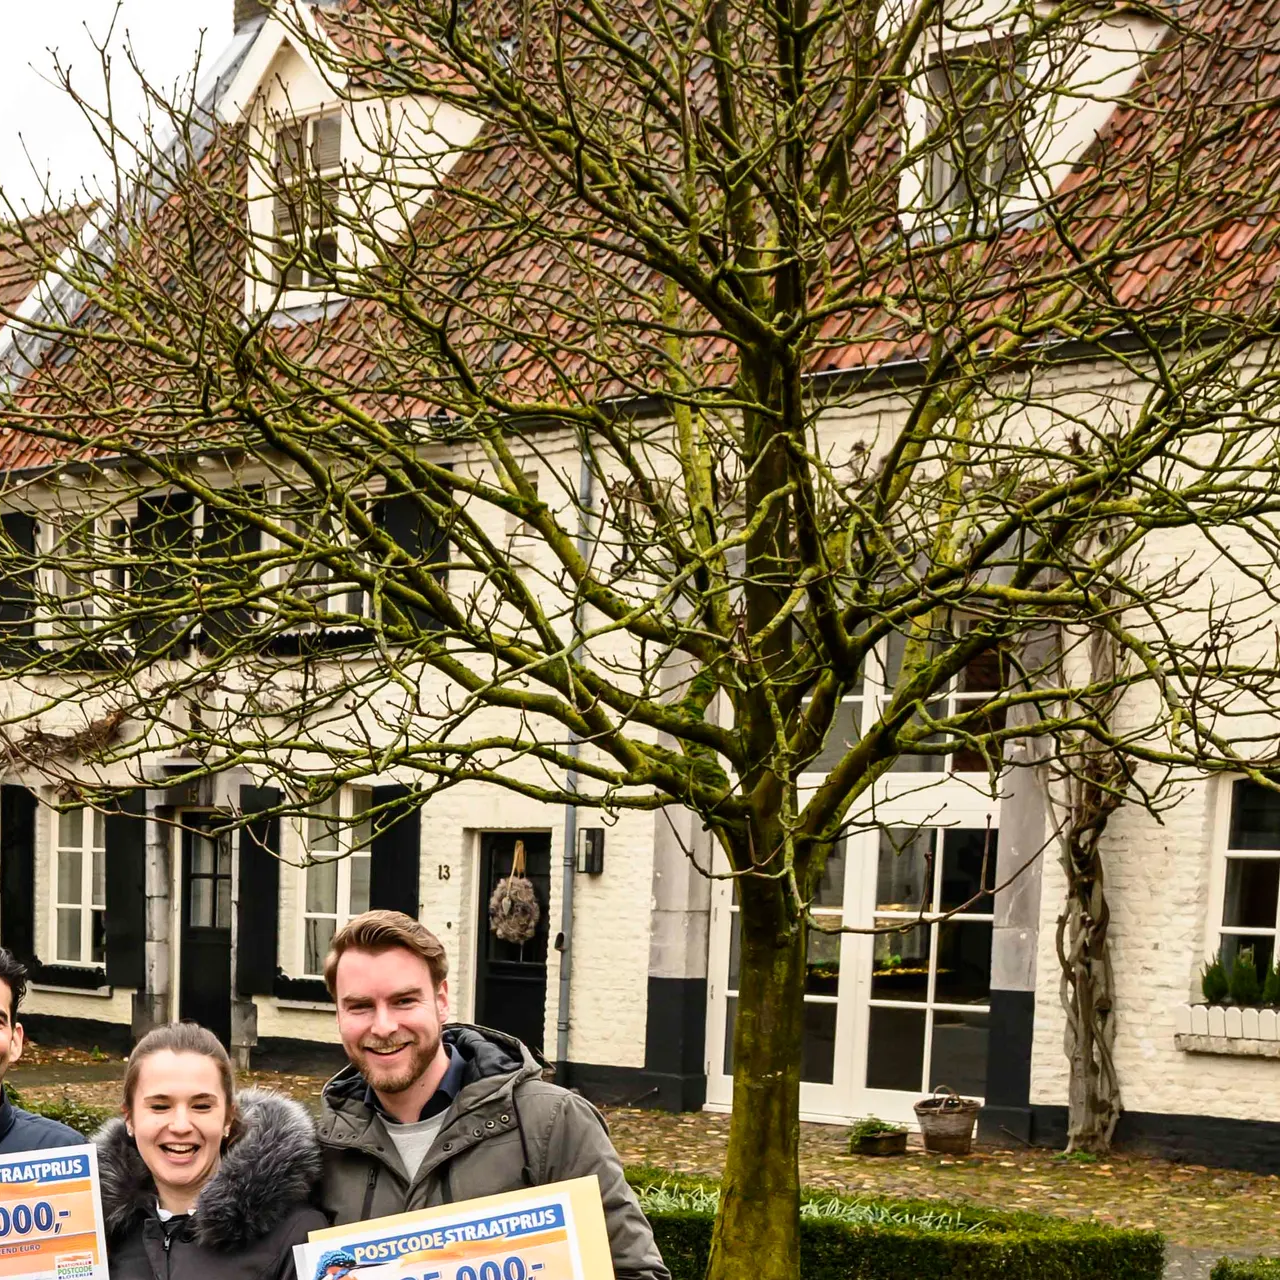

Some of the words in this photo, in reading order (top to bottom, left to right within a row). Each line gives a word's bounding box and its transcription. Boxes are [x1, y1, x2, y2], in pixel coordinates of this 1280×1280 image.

[438, 864, 451, 881] 13
[354, 1232, 443, 1262] POSTCODE
[444, 1209, 556, 1243] STRAATPRIJS
[20, 1244, 41, 1252] EURO
[57, 1265, 93, 1276] POSTCODE
